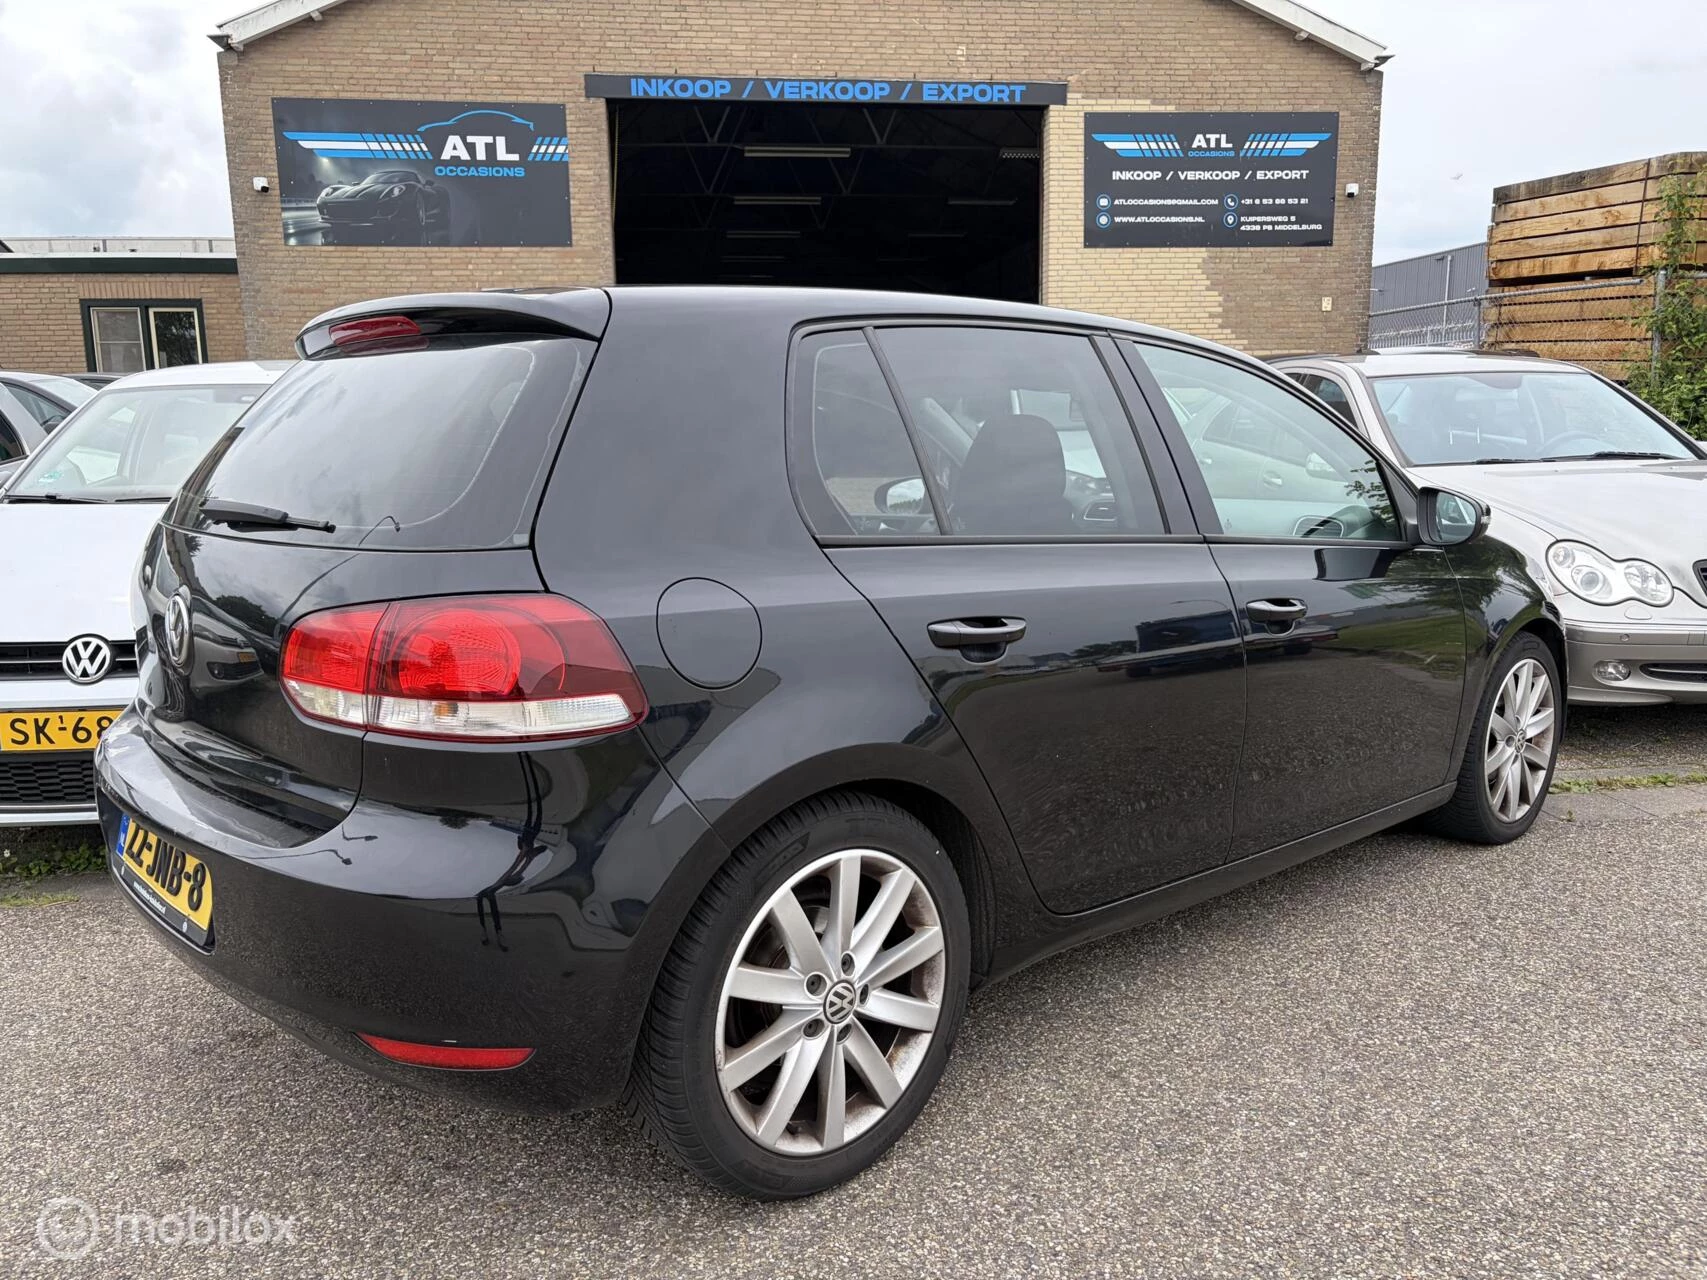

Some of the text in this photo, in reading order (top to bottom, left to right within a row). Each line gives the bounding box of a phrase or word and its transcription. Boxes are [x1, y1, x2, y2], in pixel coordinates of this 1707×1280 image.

[630, 78, 1027, 104] INKOOP / VERKOOP / EXPORT
[1191, 134, 1233, 148] ATL
[440, 135, 520, 161] ATL
[434, 166, 526, 178] OCCASIONS
[1112, 170, 1309, 181] INKOOP / VERKOOP / EXPORT
[1274, 223, 1323, 231] MIDDELBURG
